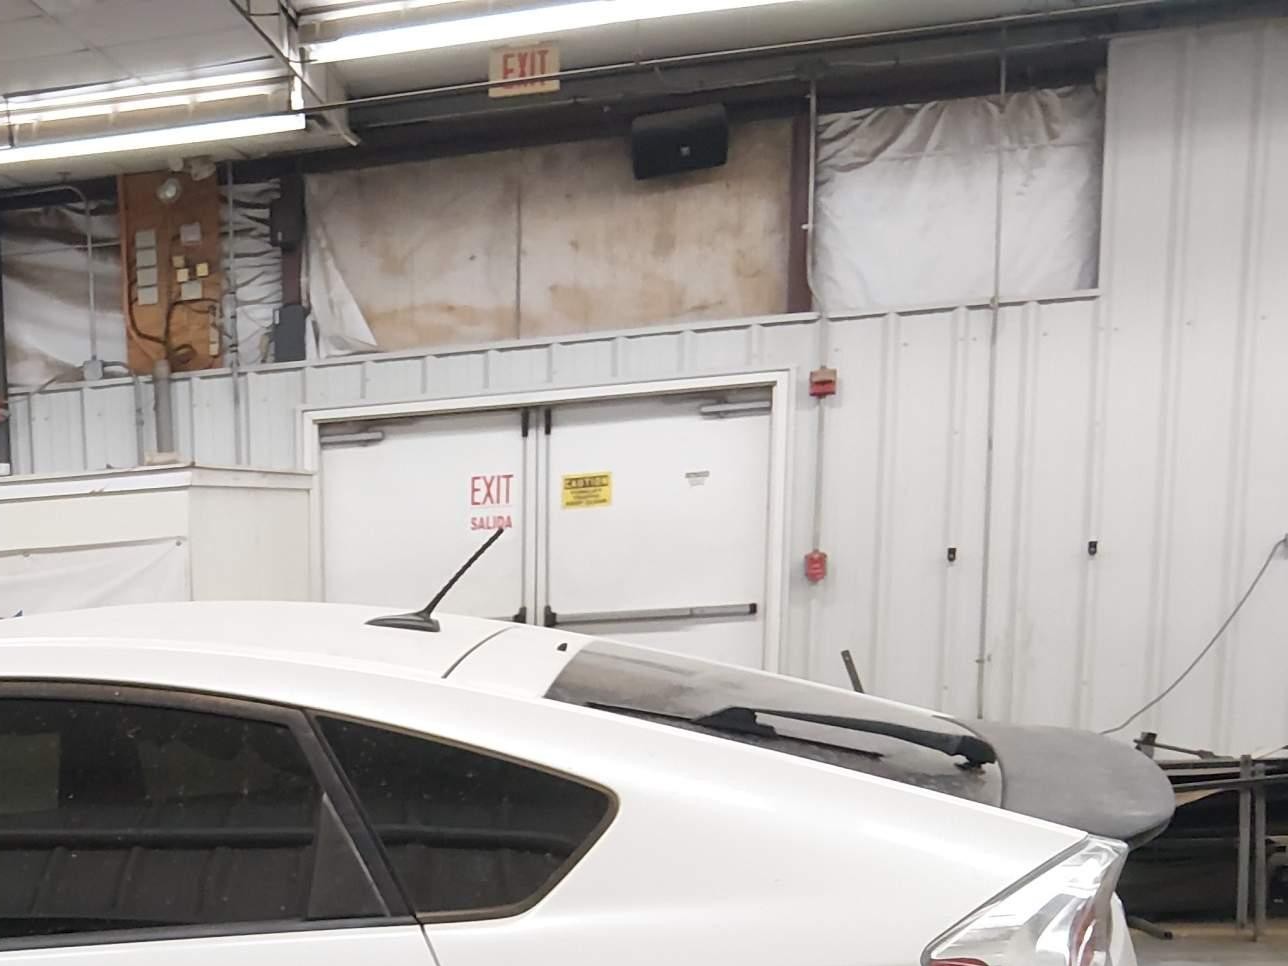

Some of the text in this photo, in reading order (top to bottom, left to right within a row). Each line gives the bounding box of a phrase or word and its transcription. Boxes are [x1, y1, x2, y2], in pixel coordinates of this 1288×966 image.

[503, 50, 549, 89] EXIT
[470, 474, 514, 506] EXIT
[470, 516, 513, 531] SALIDA
